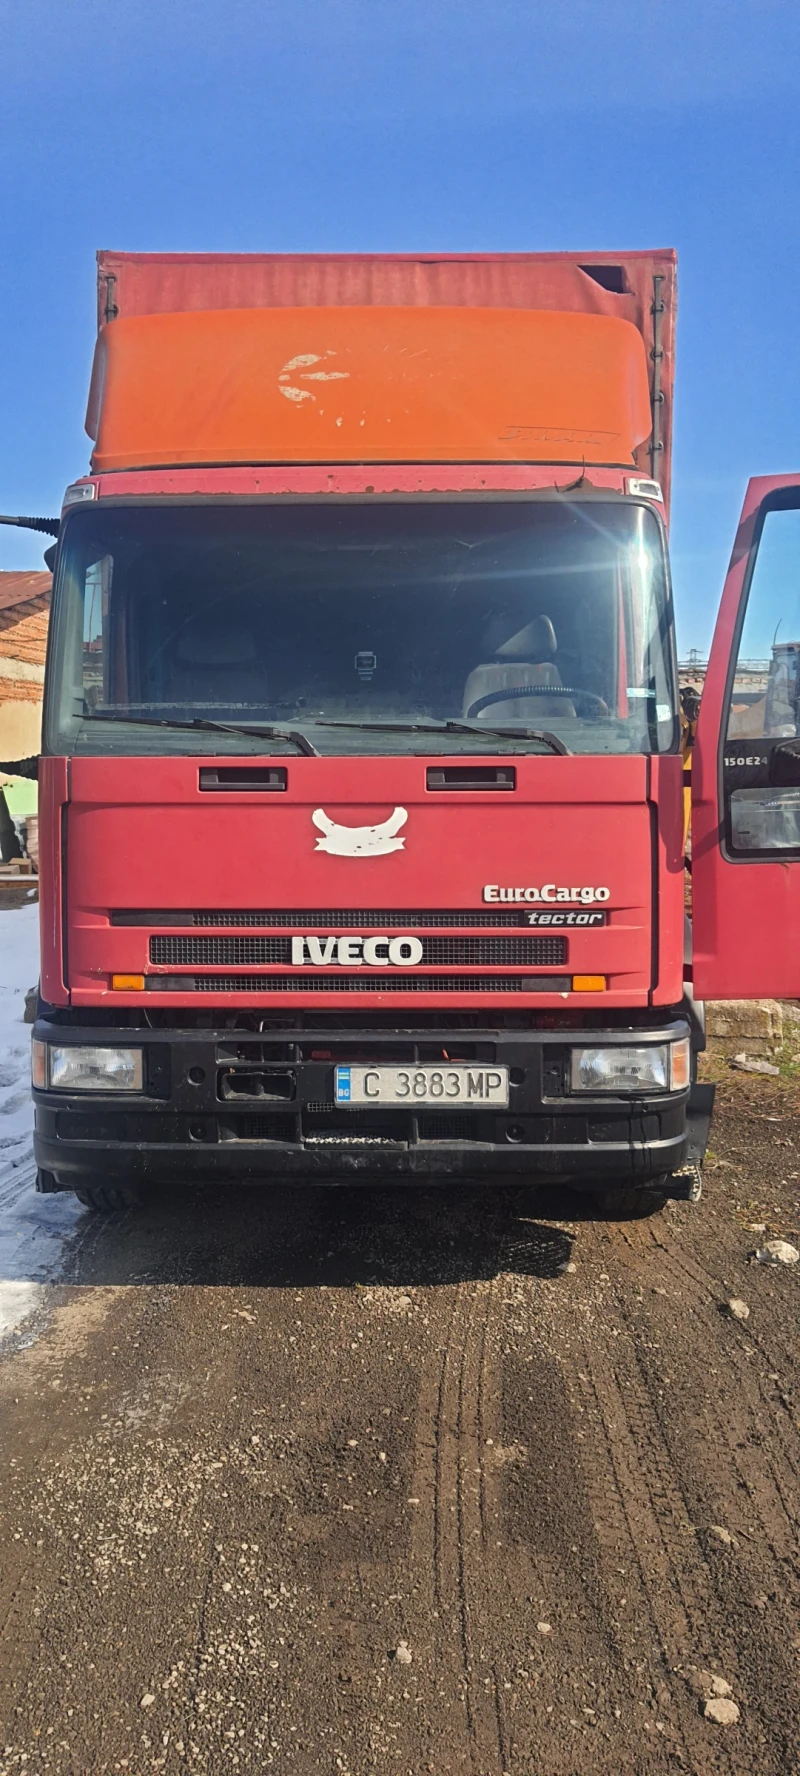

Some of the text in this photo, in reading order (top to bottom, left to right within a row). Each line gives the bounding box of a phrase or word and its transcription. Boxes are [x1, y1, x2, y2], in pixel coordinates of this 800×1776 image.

[723, 756, 768, 766] 150E24
[483, 884, 610, 904] EuroCargo
[527, 911, 603, 925] tector
[291, 936, 423, 966] IVECO
[338, 1088, 350, 1097] BG
[363, 1072, 502, 1098] C 3883 MP
